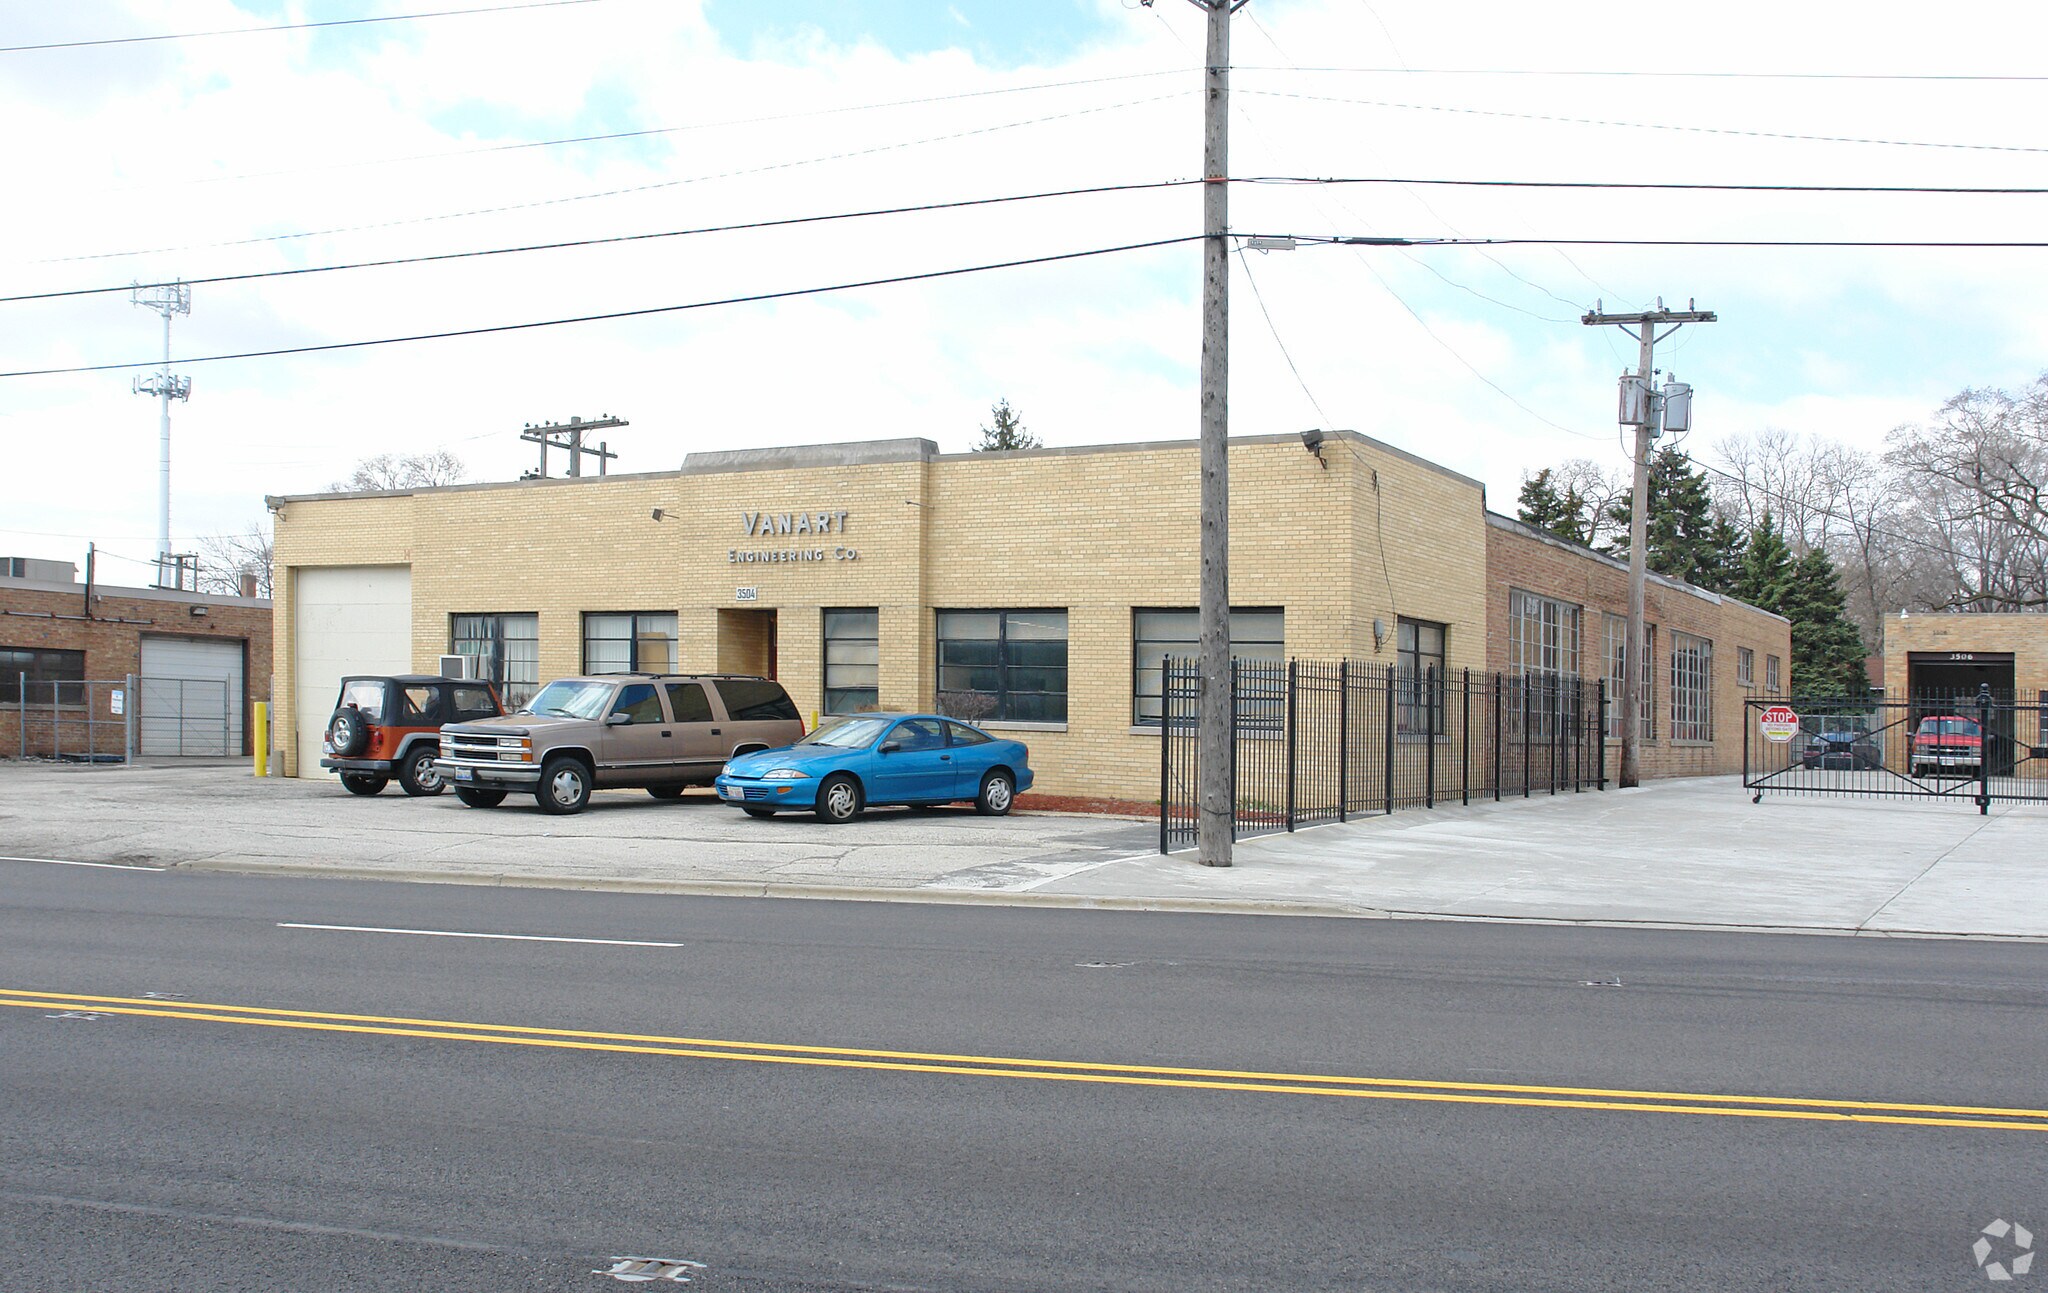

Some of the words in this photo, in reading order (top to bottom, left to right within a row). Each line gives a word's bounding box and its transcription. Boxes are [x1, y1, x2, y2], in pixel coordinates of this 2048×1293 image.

[742, 511, 848, 535] VANART
[728, 549, 824, 563] ENGINEERING
[737, 588, 756, 599] 3504
[1765, 711, 1793, 723] STOP
